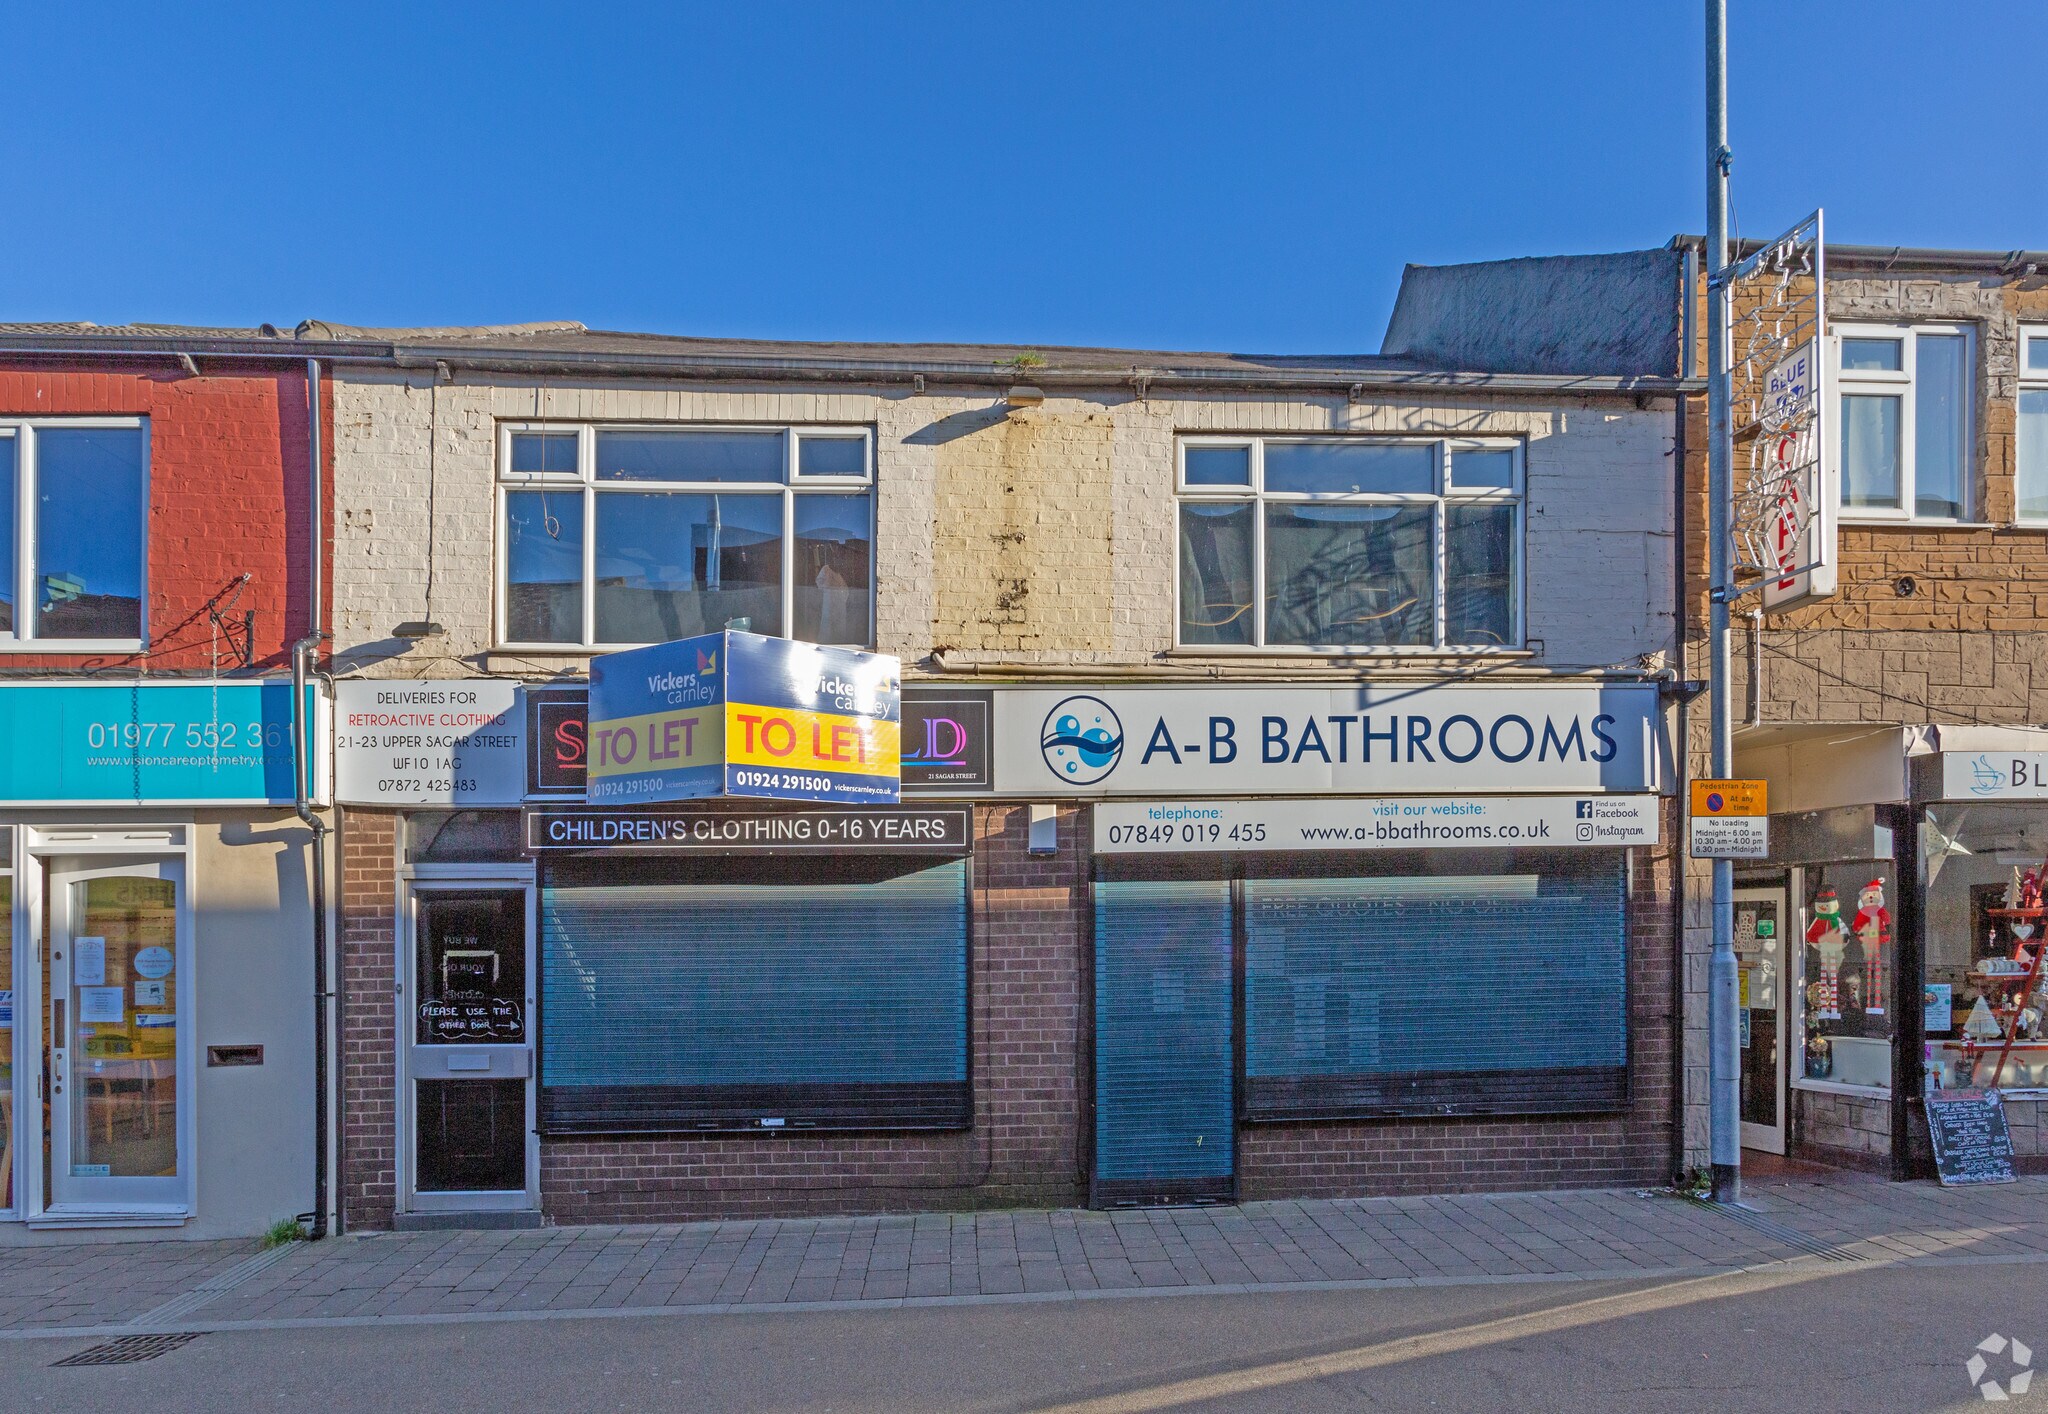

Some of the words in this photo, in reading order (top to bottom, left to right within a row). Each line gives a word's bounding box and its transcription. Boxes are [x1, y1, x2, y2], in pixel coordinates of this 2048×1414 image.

[1770, 357, 1806, 394] BLUE
[647, 671, 696, 693] Vickers
[377, 691, 446, 705] DELIVERIES
[449, 691, 477, 705] FOR
[667, 681, 716, 704] carnley
[348, 713, 435, 727] RETROACTIVE
[439, 713, 506, 727] CLOTHING
[87, 722, 177, 748] 01977
[186, 722, 238, 748] 552
[246, 722, 294, 748] 361
[337, 736, 378, 748] 21-23
[382, 735, 422, 748] UPPER
[425, 735, 470, 748] SAGAR
[473, 735, 518, 748] STREET
[595, 726, 638, 767] TO
[648, 717, 700, 762] LET
[736, 713, 797, 758] TO
[812, 722, 872, 764] LET
[1140, 714, 1238, 765] A-B
[1260, 712, 1618, 765] BATHROOMS
[392, 757, 429, 770] WF10
[435, 757, 462, 770] 1AG
[378, 779, 421, 792] 07872
[426, 779, 477, 792] 425483
[594, 782, 624, 797] 01924
[626, 777, 664, 794] 291500
[665, 777, 716, 789] vickerscarnley.co.uk
[736, 770, 780, 788] 01924
[782, 774, 832, 792] 291500
[1699, 782, 1739, 790] Pedestrian
[1741, 782, 1759, 790] Zone
[834, 783, 892, 796] vickerscarnley.co.uk
[1148, 805, 1224, 823] telephone:
[1371, 802, 1400, 817] visit
[1403, 804, 1427, 816] our
[1430, 801, 1488, 816] website:
[1595, 808, 1639, 818] Facebook
[549, 819, 687, 841] CHILDREN'S
[693, 819, 812, 841] CLOTHING
[816, 818, 863, 839] 0-16
[867, 817, 946, 839] YEARS
[1300, 818, 1550, 841] www.a-bbathrooms.co.uk
[1722, 820, 1749, 828] loading
[1108, 824, 1174, 844] 07849
[1182, 823, 1221, 843] 019
[1227, 822, 1267, 842] 455
[1595, 825, 1645, 840] Instagram
[1694, 837, 1715, 845] 10.30
[1752, 838, 1763, 846] pm
[1695, 845, 1713, 853] 6.30
[422, 1006, 459, 1017] PLEASE
[465, 1007, 488, 1016] USE
[492, 1007, 513, 1016] THE
[438, 1020, 466, 1030] OTHER
[470, 1020, 492, 1030] DOOR
